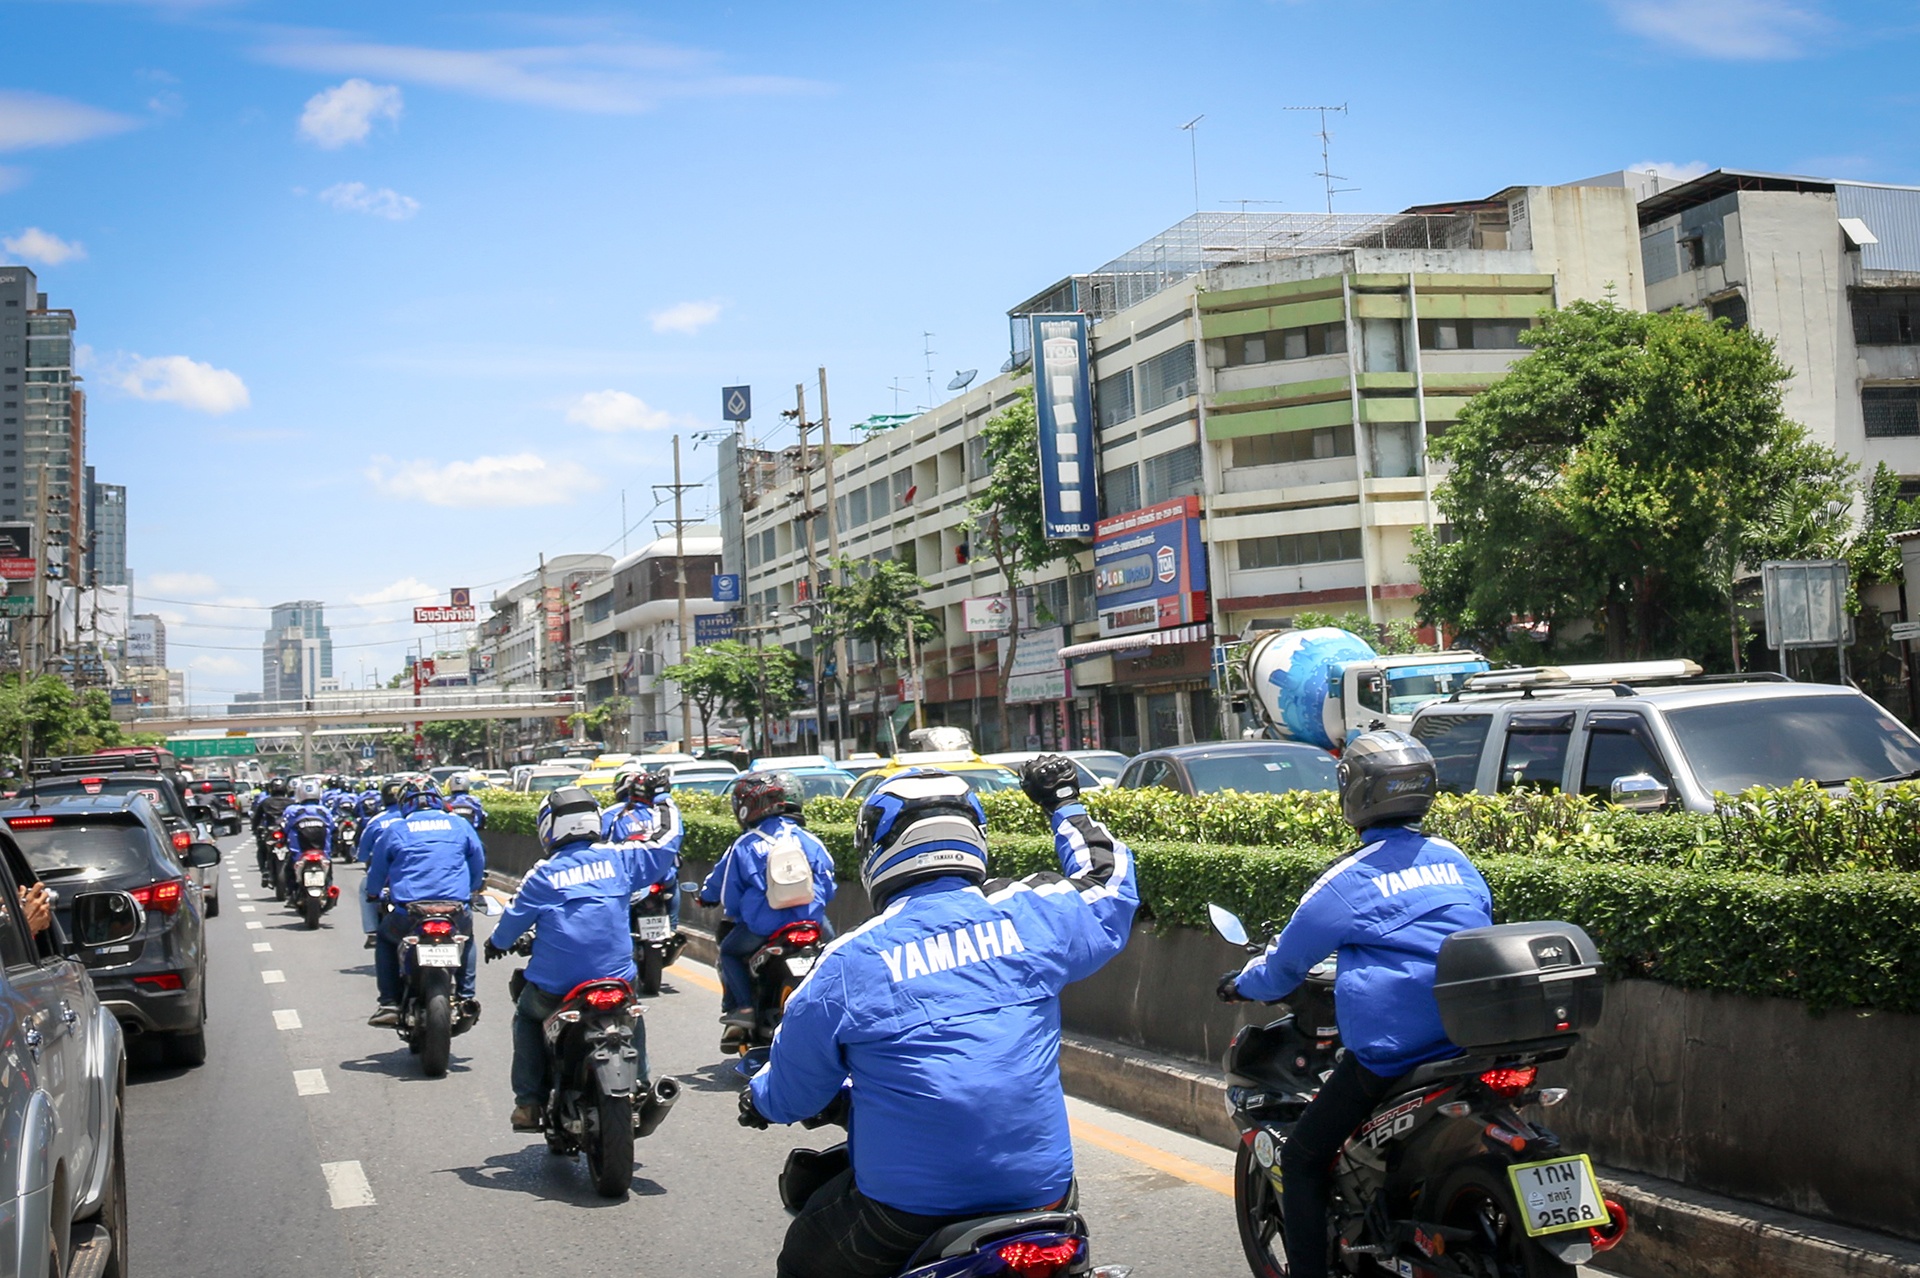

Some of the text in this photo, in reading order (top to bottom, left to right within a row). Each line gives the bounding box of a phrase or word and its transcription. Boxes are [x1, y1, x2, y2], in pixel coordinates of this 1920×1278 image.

[1046, 345, 1076, 358] TOA
[1055, 523, 1090, 533] WORLD
[1158, 556, 1174, 573] TOA
[406, 819, 452, 832] YAMAHA
[548, 860, 616, 890] YAMAHA
[1371, 863, 1464, 898] YAMAHA
[879, 918, 1025, 983] YAMAHA
[1368, 1113, 1415, 1150] 150
[1532, 1162, 1576, 1186] 1กม
[1547, 1187, 1572, 1204] ชลบุรี
[1538, 1204, 1595, 1228] 2568
